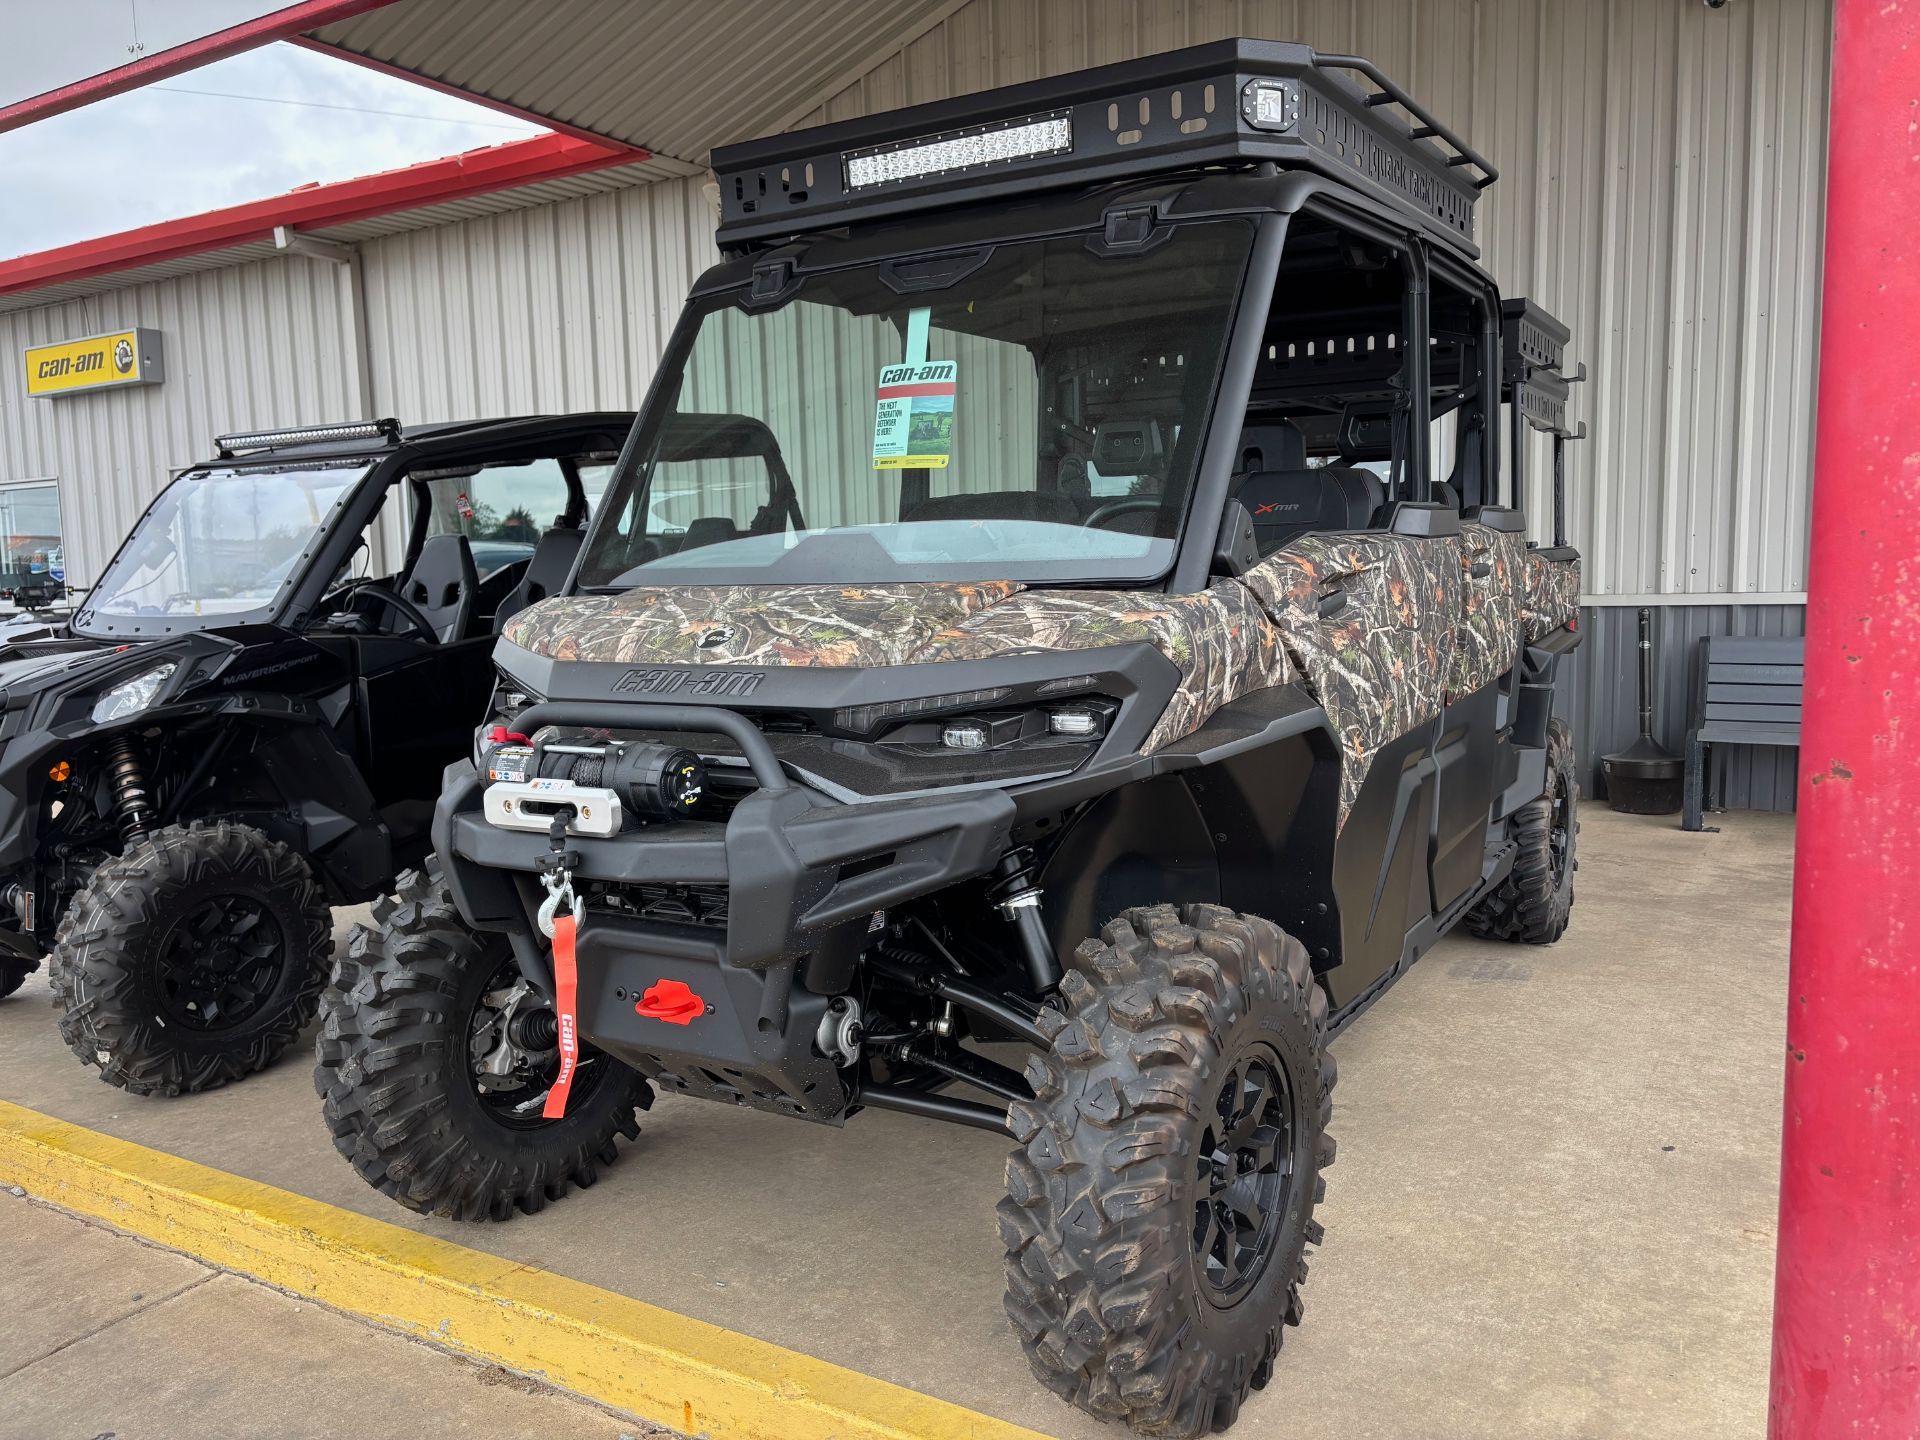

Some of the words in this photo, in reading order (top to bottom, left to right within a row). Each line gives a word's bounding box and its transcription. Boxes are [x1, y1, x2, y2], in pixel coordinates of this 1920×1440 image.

[38, 351, 104, 379] can-am
[881, 364, 953, 384] can-am
[878, 409, 903, 419] GENERATION
[886, 401, 898, 410] NEXT
[877, 418, 897, 428] DEFENDER
[707, 634, 729, 642] BRP
[223, 661, 288, 686] MAVERICK
[611, 669, 767, 697] can-am
[558, 1013, 575, 1084] can-am
